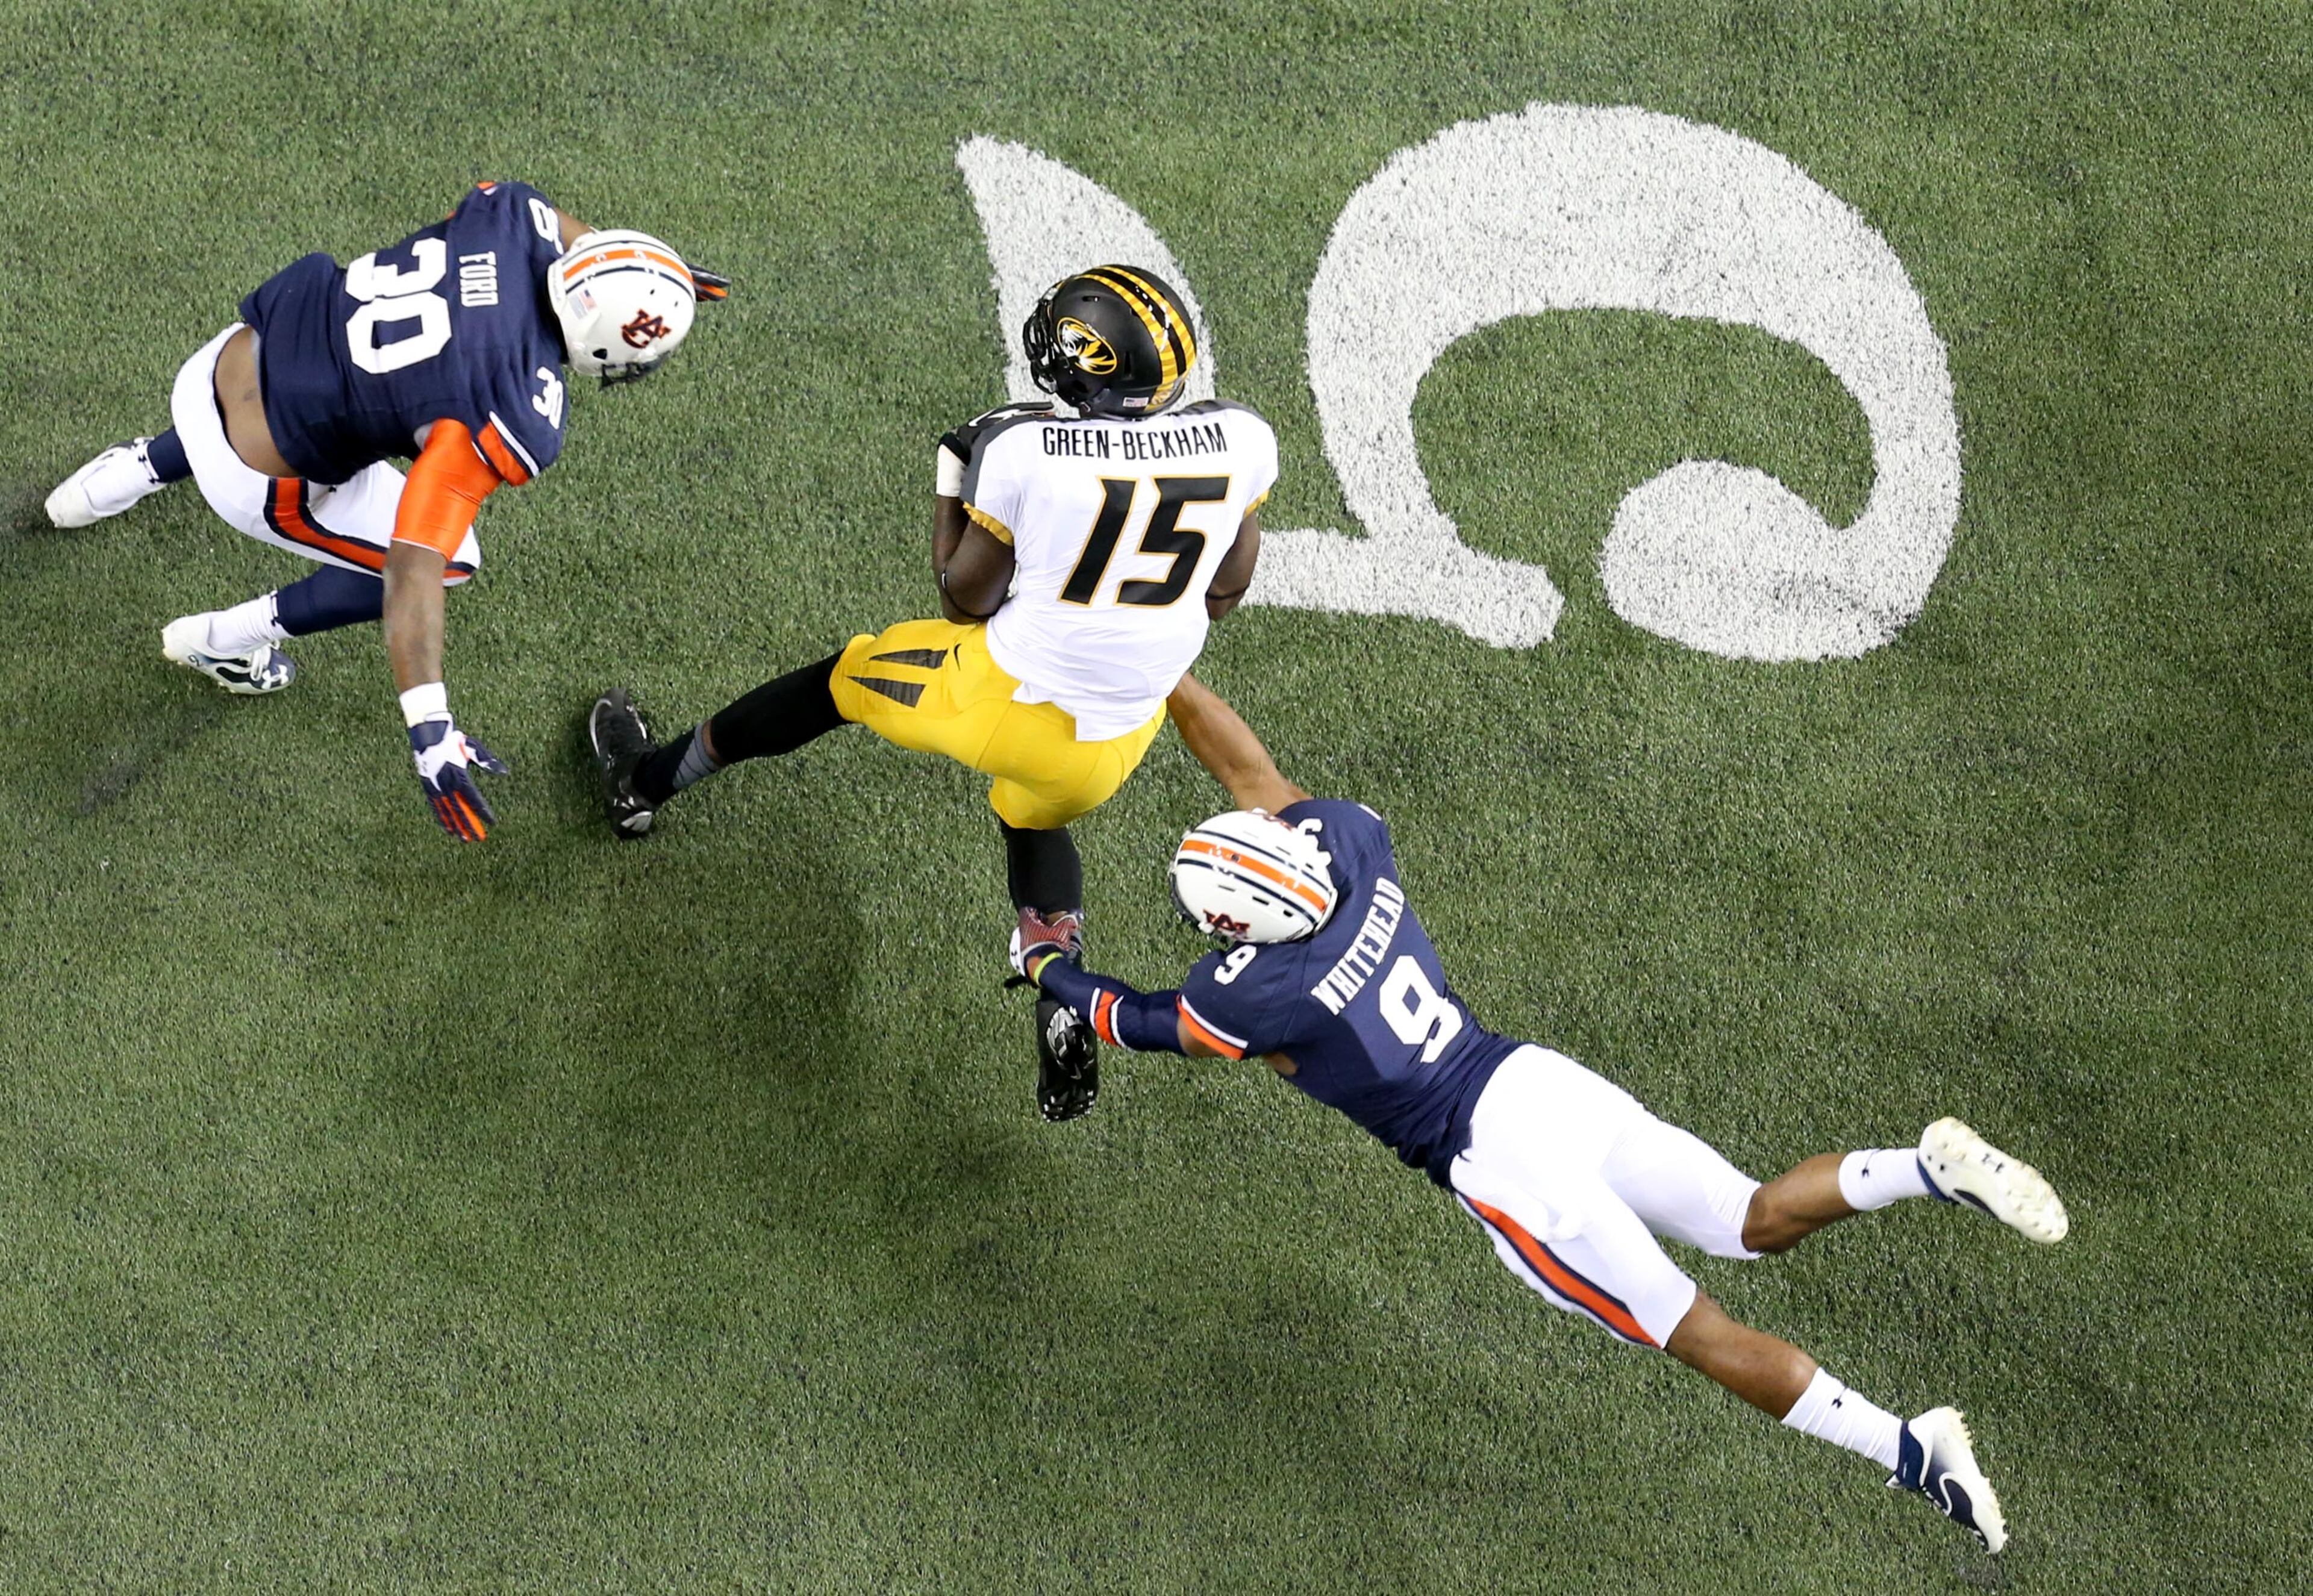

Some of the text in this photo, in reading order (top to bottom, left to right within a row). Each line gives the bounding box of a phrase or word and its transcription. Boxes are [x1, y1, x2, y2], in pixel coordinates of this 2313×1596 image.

[346, 237, 452, 374] 30
[459, 251, 499, 307] FORD
[1042, 423, 1228, 460] GREEN-BECKHAM
[1057, 474, 1232, 609] 15
[1214, 944, 1257, 985] 9
[1311, 877, 1405, 1016] WHITEHEAD
[1379, 955, 1462, 1063] 9
